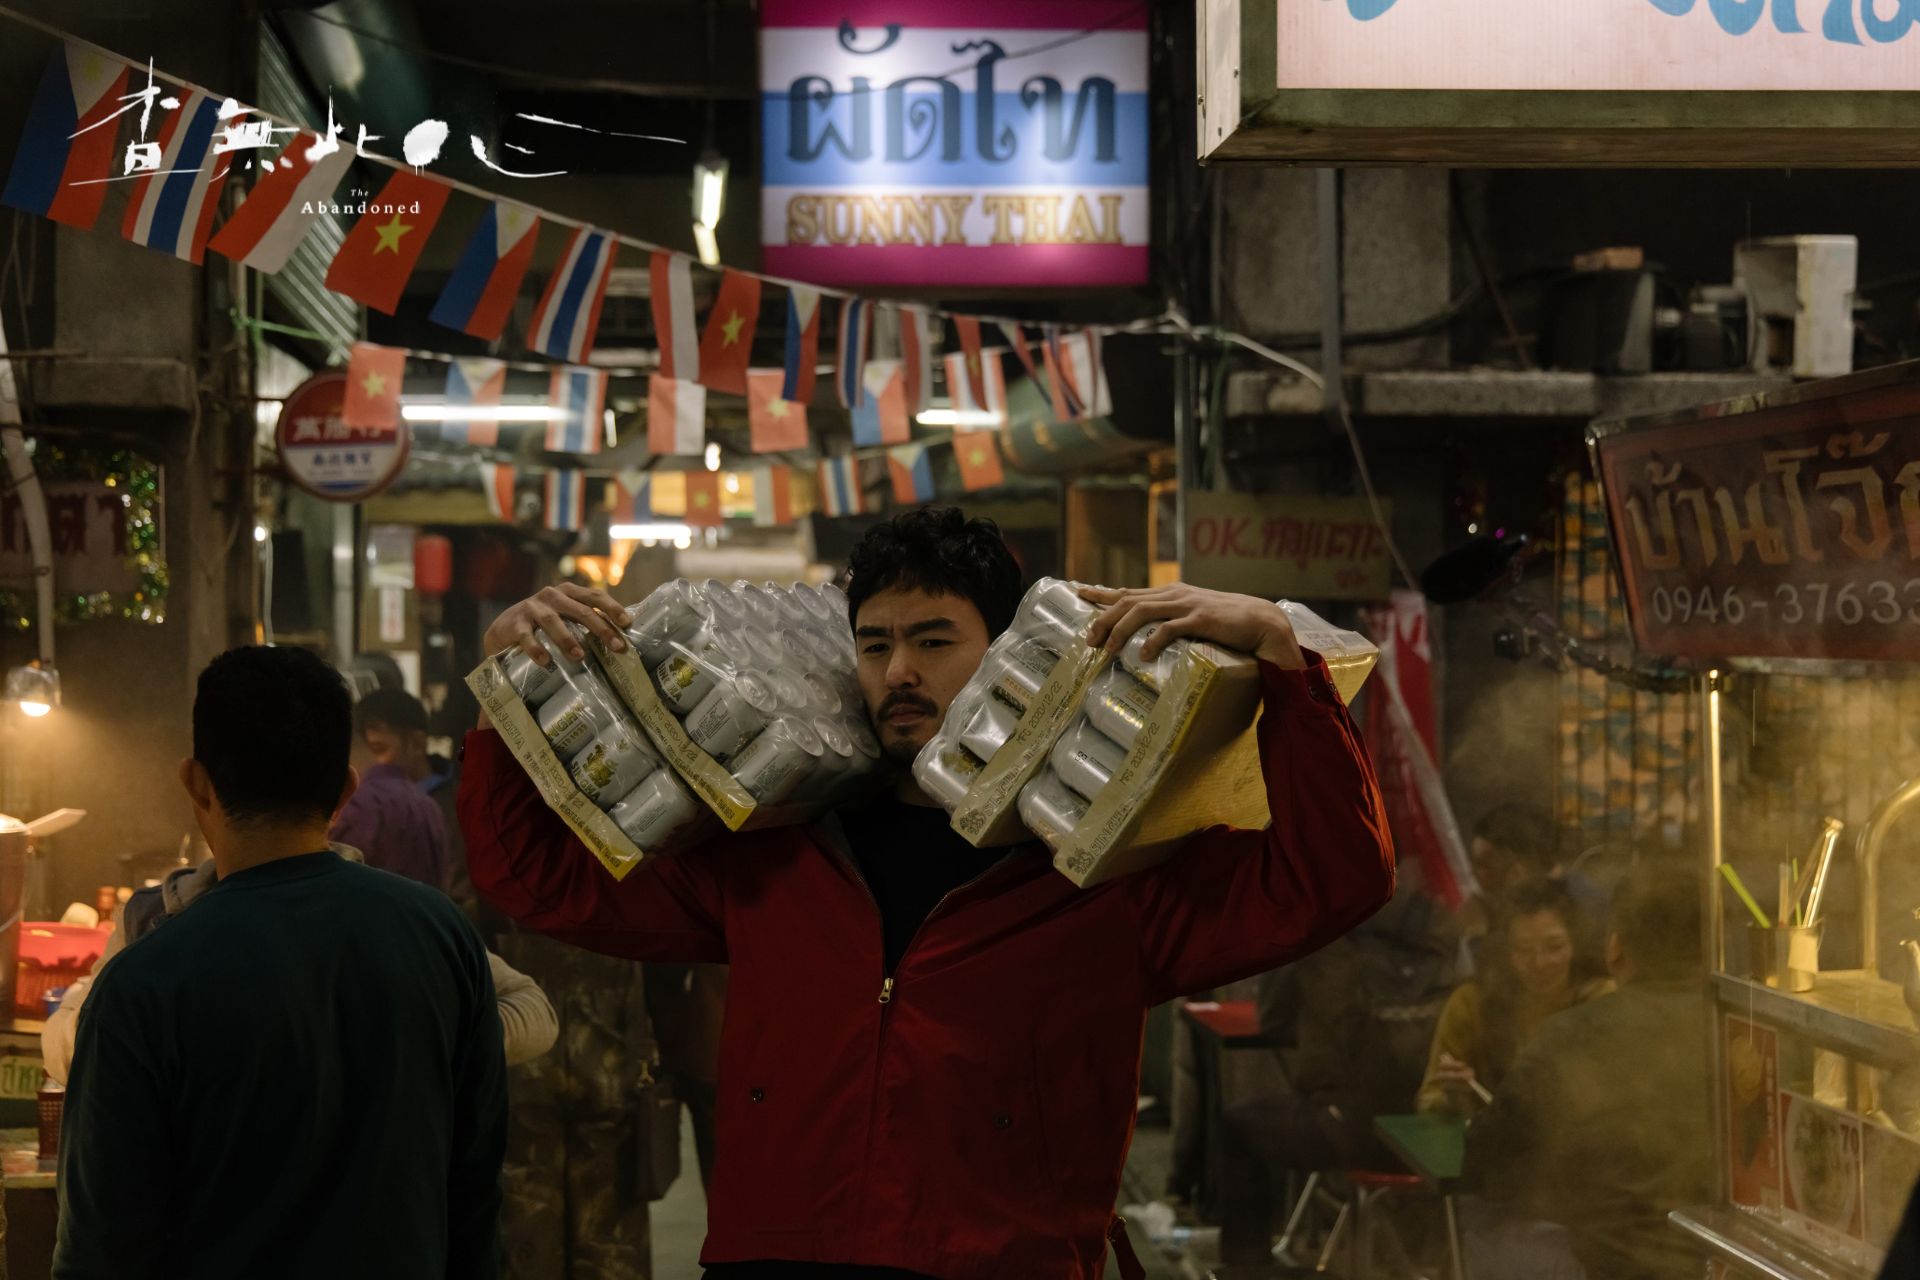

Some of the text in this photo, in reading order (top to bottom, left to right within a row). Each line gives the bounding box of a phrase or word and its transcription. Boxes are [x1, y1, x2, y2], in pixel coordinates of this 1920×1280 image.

[788, 20, 1117, 164] ผัดไท
[786, 195, 1125, 247] SUNNY THAI
